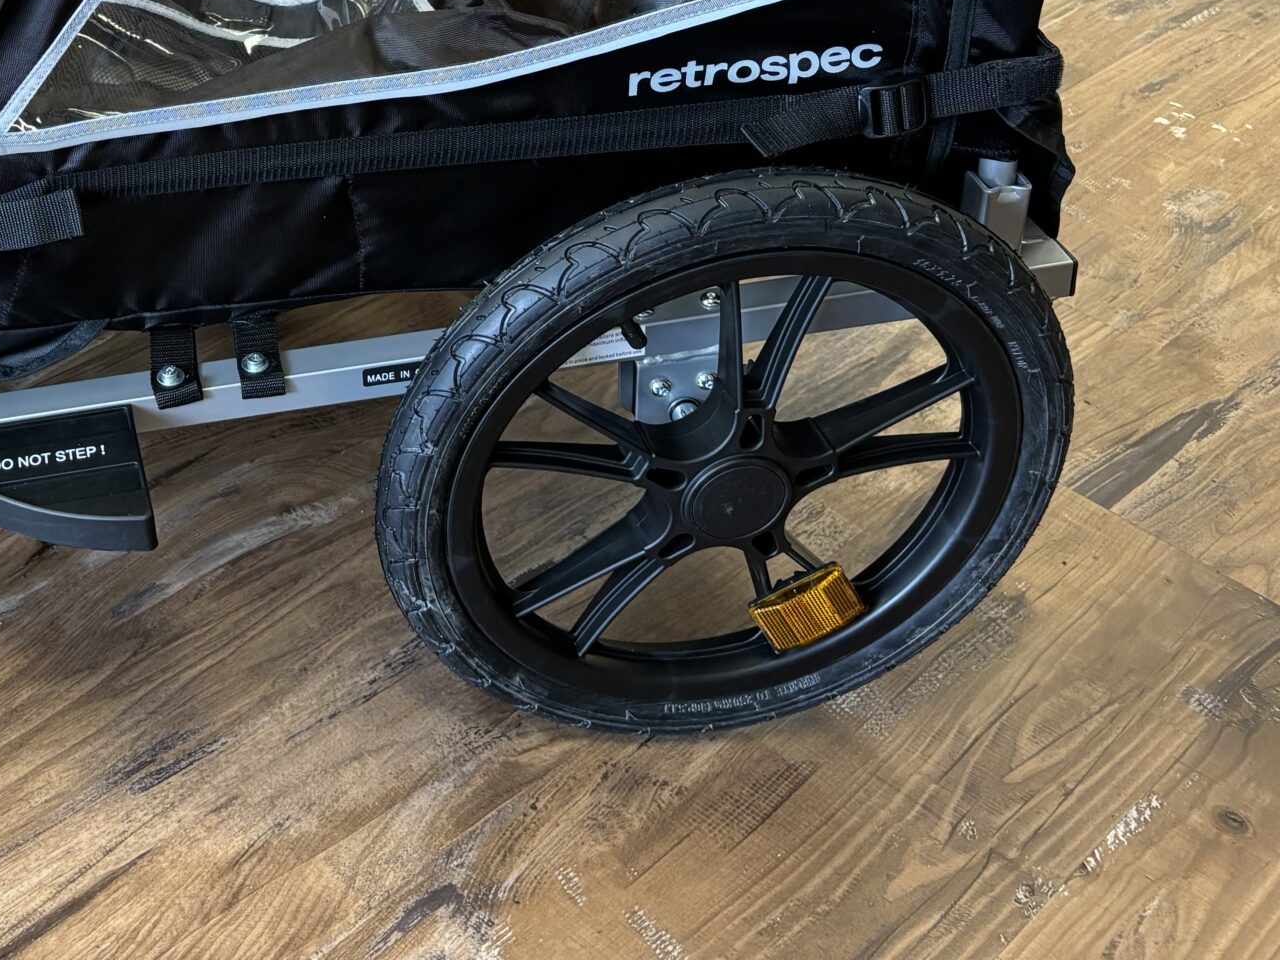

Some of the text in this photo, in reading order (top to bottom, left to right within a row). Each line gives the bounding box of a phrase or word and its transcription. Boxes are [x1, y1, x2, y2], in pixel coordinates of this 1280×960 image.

[628, 43, 883, 97] retrospec
[367, 371, 395, 383] MADE
[400, 369, 410, 379] IN
[17, 452, 51, 468] NOT
[55, 445, 97, 462] STEP
[776, 672, 821, 696] INFLATE
